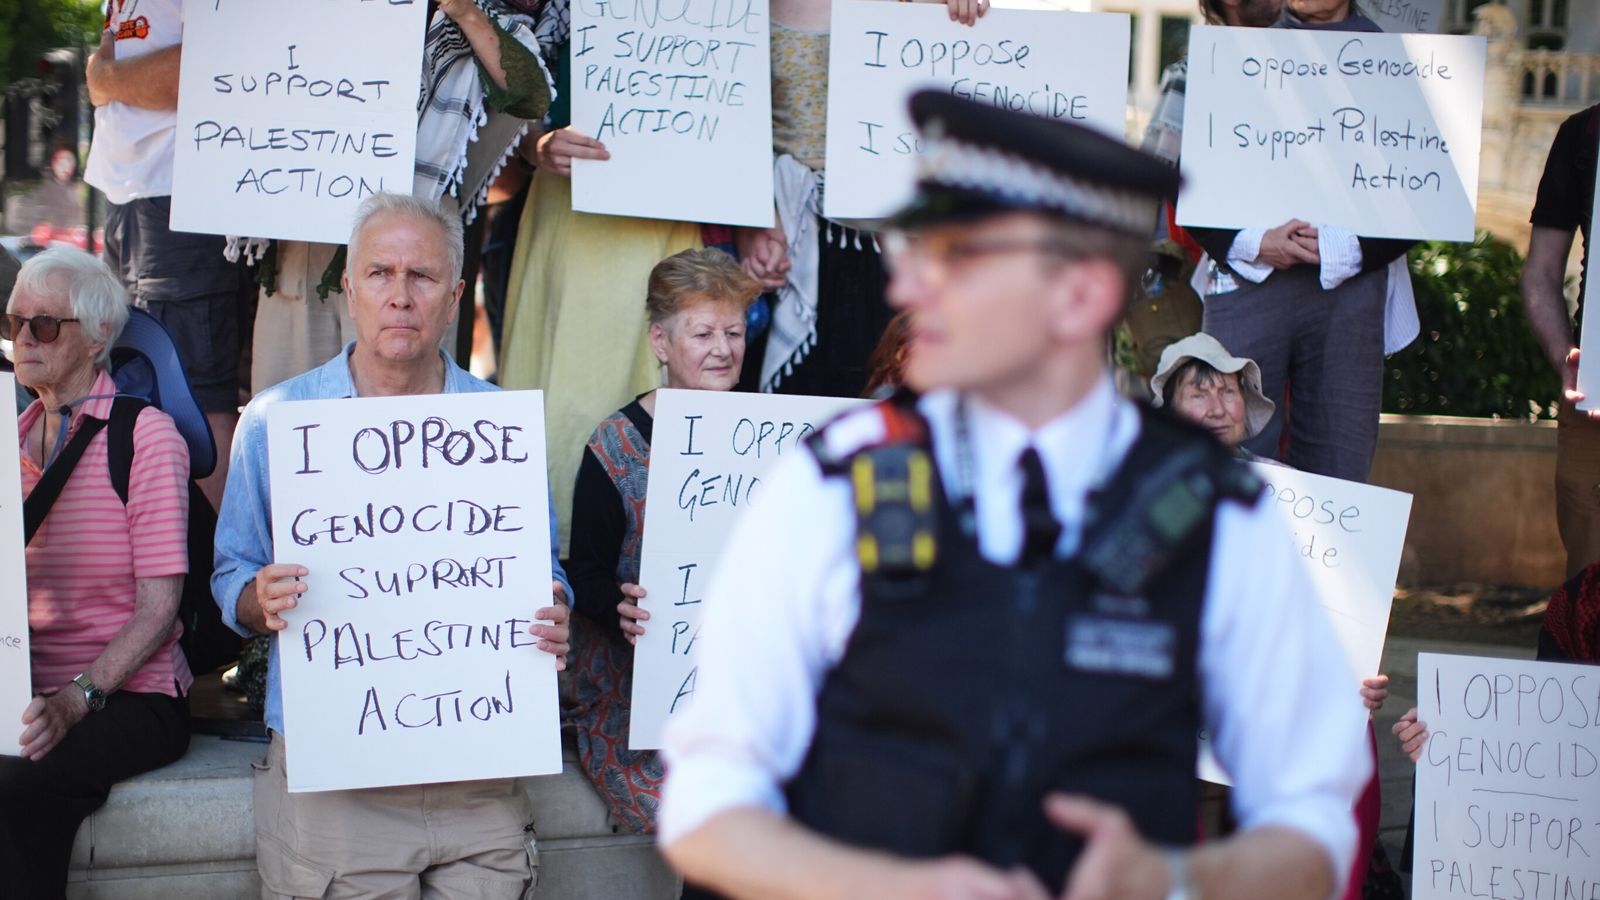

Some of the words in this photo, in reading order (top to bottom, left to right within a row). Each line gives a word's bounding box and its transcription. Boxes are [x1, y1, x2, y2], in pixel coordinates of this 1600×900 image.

[287, 45, 300, 70] I
[575, 25, 598, 57] I
[614, 31, 756, 73] SUPPORT
[864, 31, 889, 68] I
[213, 72, 390, 102] SUPPORT
[585, 64, 747, 106] PALESTINE
[1242, 57, 1328, 89] oppose
[194, 120, 399, 157] PALESTINE
[596, 102, 719, 141] ACTION
[858, 121, 884, 155] I
[1207, 112, 1213, 148] I
[1332, 107, 1449, 154] Palestine
[235, 168, 384, 199] ACTION
[1351, 162, 1441, 192] Action
[293, 424, 324, 475] I
[352, 416, 529, 475] OPPOSE
[680, 415, 704, 456] I
[732, 418, 817, 459] OPPO
[291, 501, 524, 546] GENOCIDE
[674, 563, 702, 606] I
[303, 618, 538, 670] PALESTINE
[358, 670, 514, 736] ACTION
[1434, 667, 1442, 716] I
[1463, 673, 1600, 729] OPPOS
[1427, 730, 1599, 787] GENOCID
[1433, 800, 1439, 843] I
[1463, 804, 1600, 858] SUPPOR
